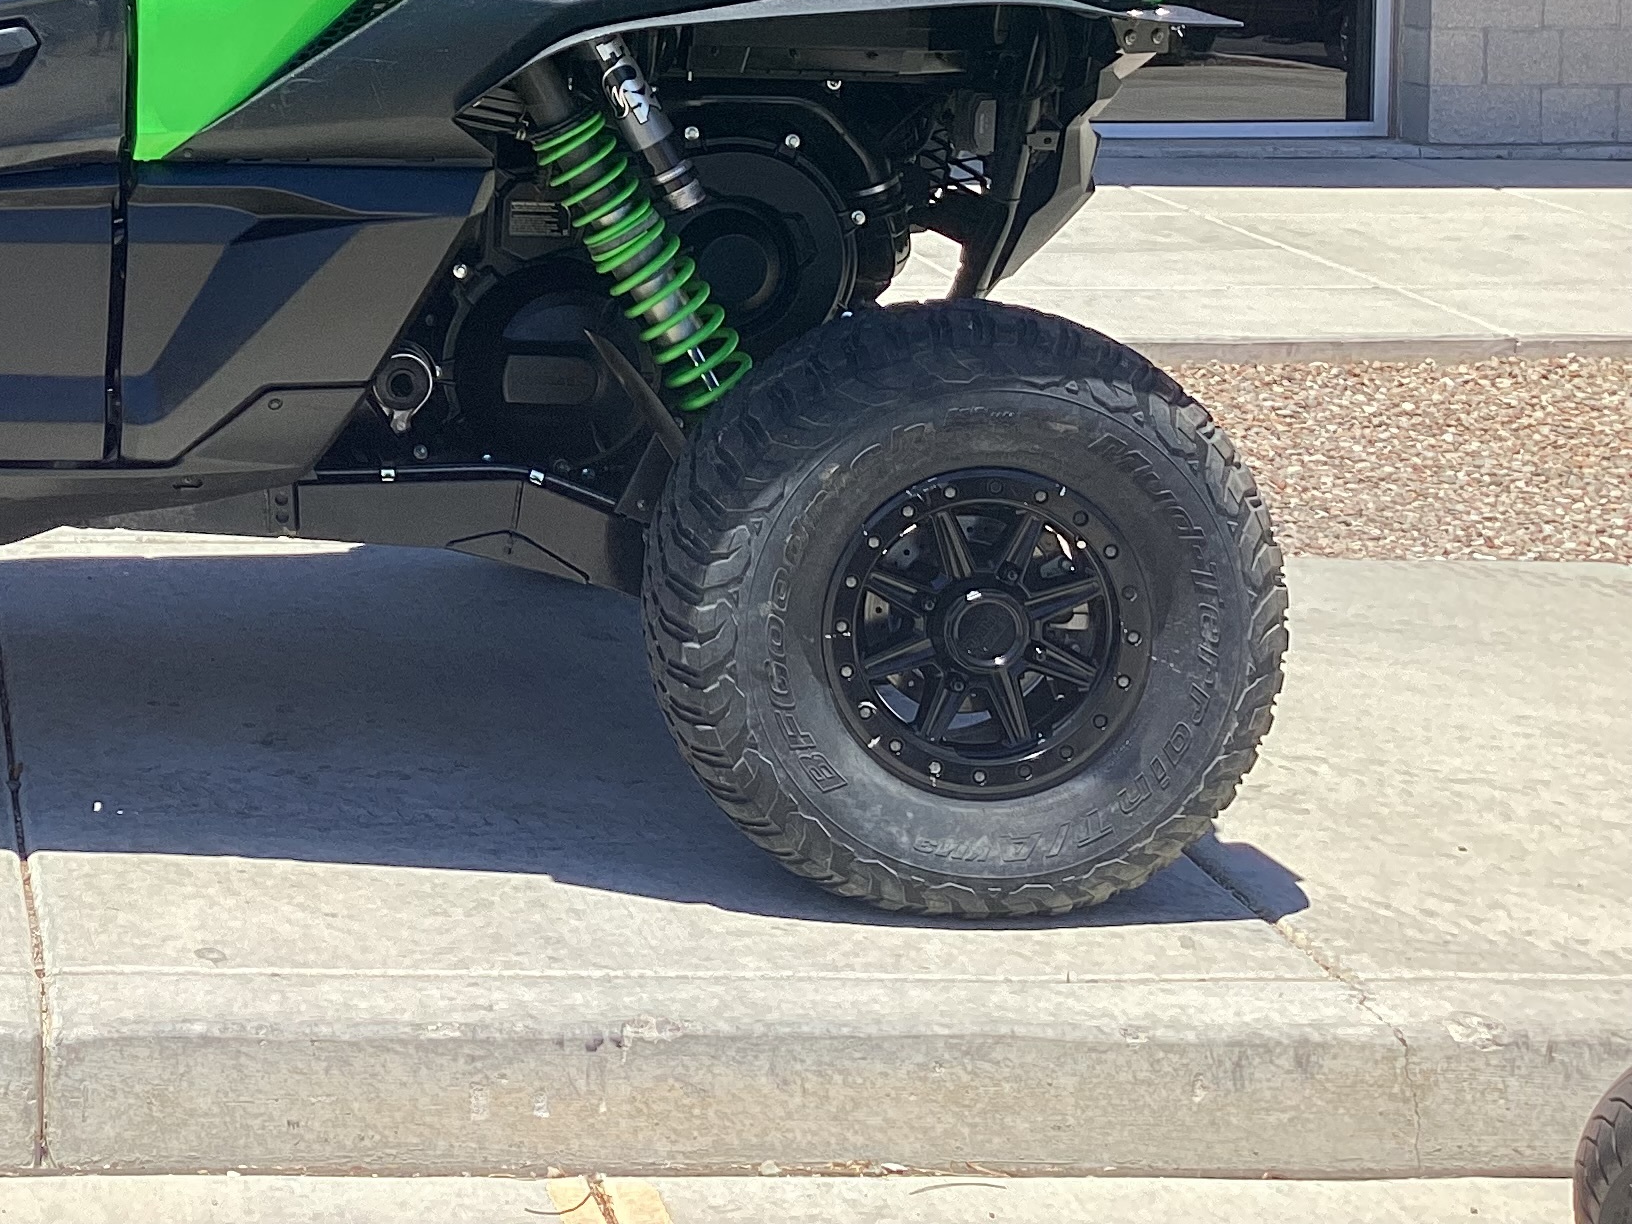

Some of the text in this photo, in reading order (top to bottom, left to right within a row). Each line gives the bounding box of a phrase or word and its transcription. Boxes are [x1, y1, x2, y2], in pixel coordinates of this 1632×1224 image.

[765, 422, 935, 792] BFGoodrich
[1088, 432, 1225, 816] Mud-Terrain
[999, 808, 1114, 863] T/A
